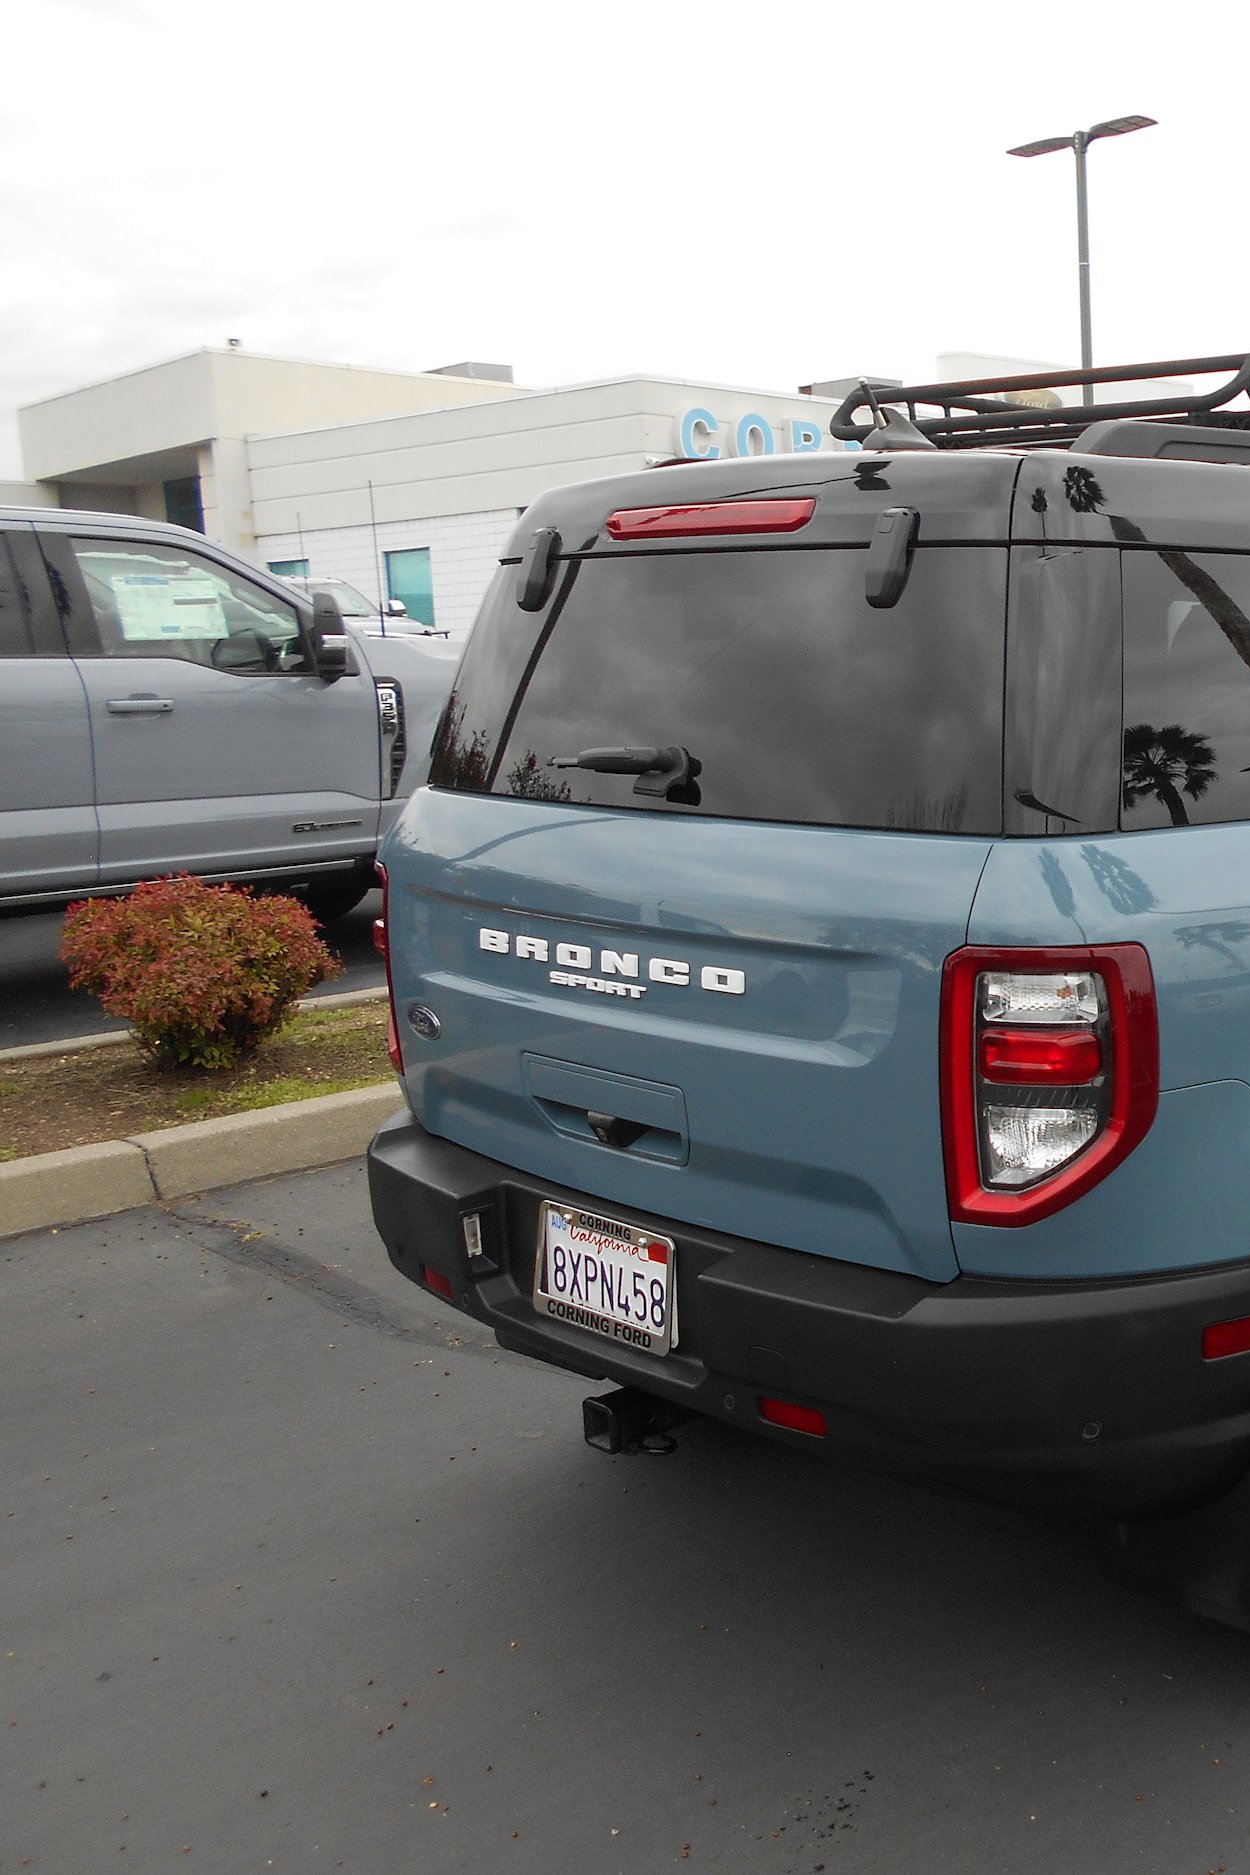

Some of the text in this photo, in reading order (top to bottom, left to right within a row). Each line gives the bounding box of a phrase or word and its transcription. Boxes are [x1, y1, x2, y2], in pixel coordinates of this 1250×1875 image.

[480, 928, 745, 994] BRONCO
[550, 971, 646, 998] SPORT
[570, 1225, 649, 1262] California
[579, 1213, 631, 1240] CORNING
[554, 1246, 665, 1327] 8XPN458
[547, 1300, 609, 1334] CORNING
[614, 1323, 651, 1349] FORD
